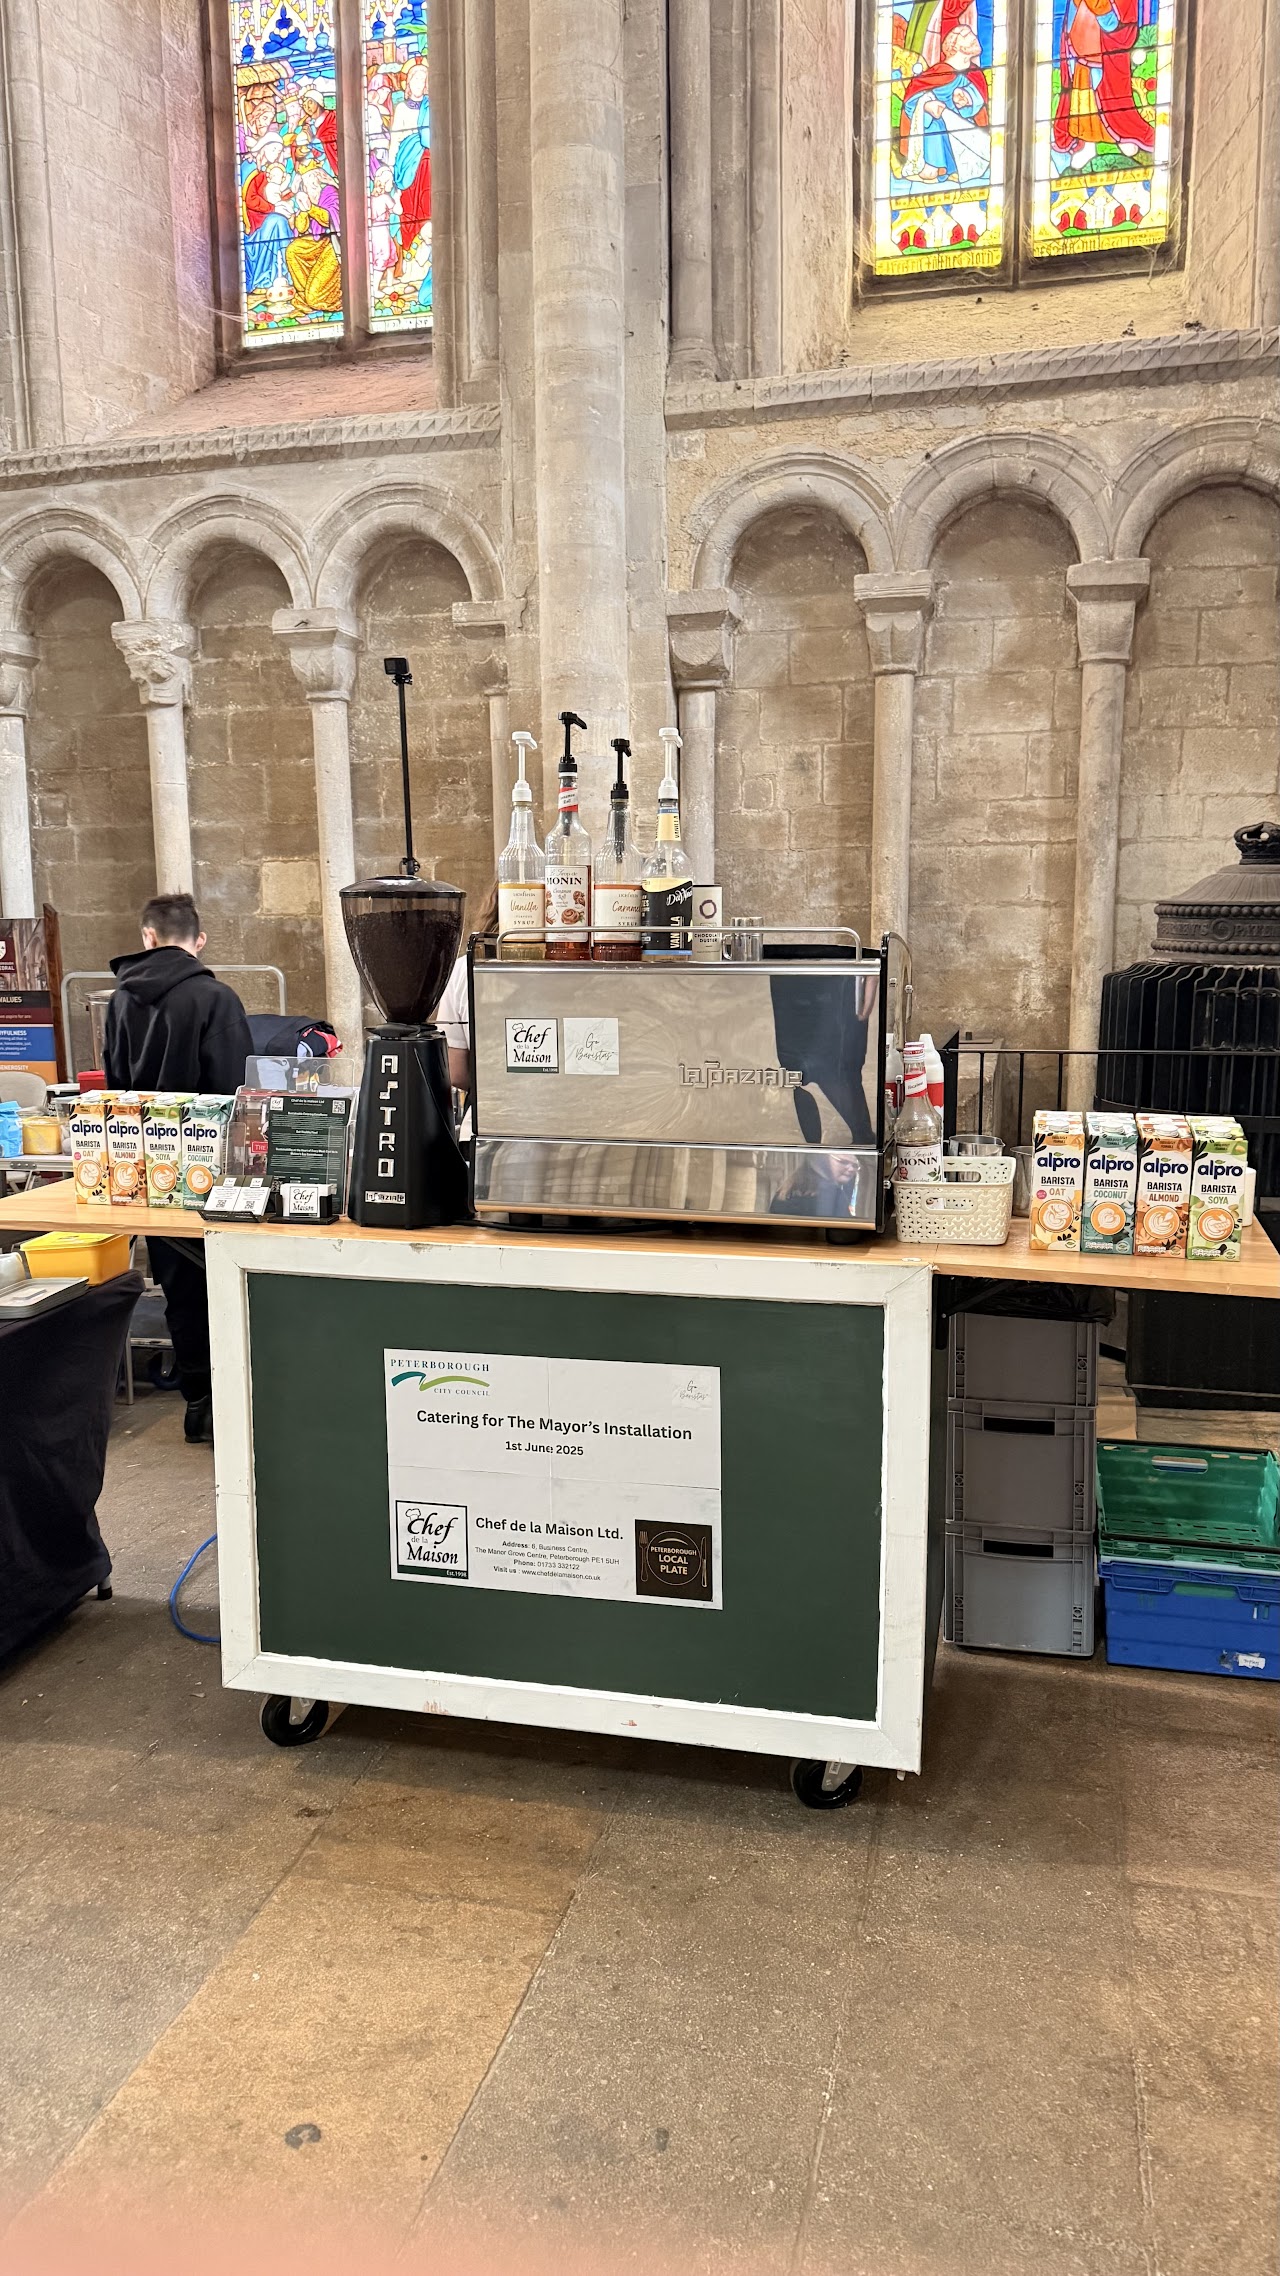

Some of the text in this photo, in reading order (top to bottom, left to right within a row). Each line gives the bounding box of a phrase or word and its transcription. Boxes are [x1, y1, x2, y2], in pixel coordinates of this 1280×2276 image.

[510, 900, 538, 912] Vanilla
[670, 916, 681, 949] VANLA
[513, 1024, 552, 1050] Chef
[585, 1032, 600, 1051] Go
[513, 1048, 551, 1064] Maison
[378, 1054, 399, 1178] ASTRO
[72, 1120, 102, 1136] alpro
[108, 1121, 140, 1138] alpro
[146, 1123, 178, 1140] alpro
[184, 1124, 218, 1140] alpro
[76, 1140, 100, 1148] BARISTA
[112, 1142, 137, 1150] BARISTA
[150, 1144, 176, 1152] BARISTA
[188, 1144, 214, 1153] BARISTA
[82, 1150, 94, 1158] OAT
[900, 1156, 938, 1166] MONIN
[1037, 1152, 1080, 1172] alpro
[1090, 1154, 1134, 1174] alpro
[1144, 1158, 1188, 1177] alpro
[1198, 1160, 1243, 1180] alpro
[1041, 1176, 1075, 1186] BARISTA
[1094, 1178, 1128, 1188] BARISTA
[1147, 1182, 1182, 1192] BARISTA
[1049, 1188, 1066, 1196] OAT
[1094, 1190, 1128, 1199] COCONUT
[1201, 1184, 1237, 1194] BARISTA
[293, 1190, 314, 1204] Chef
[1149, 1194, 1180, 1202] ALMOND
[1208, 1196, 1229, 1204] SOYA
[390, 1358, 490, 1372] PETERBOROUGH
[416, 1410, 479, 1428] Catering
[482, 1413, 504, 1427] for
[508, 1416, 536, 1430] The
[604, 1422, 692, 1440] Installation
[505, 1441, 584, 1456] 1st June 2025
[407, 1512, 458, 1544] Chef
[476, 1517, 624, 1540] Chef de la Maison Ltd.
[422, 1536, 428, 1544] la
[502, 1540, 530, 1549] Address:
[538, 1544, 566, 1552] Business
[568, 1546, 589, 1554] Centre,
[406, 1542, 458, 1564] Maison
[475, 1546, 486, 1554] The
[550, 1553, 590, 1563] Peterborough
[591, 1556, 604, 1564] PE1
[650, 1546, 697, 1556] PETERBOROUGH
[513, 1559, 580, 1570] Phone: 01733 332122
[658, 1554, 688, 1565] LOCAL
[660, 1564, 688, 1576] PLATE
